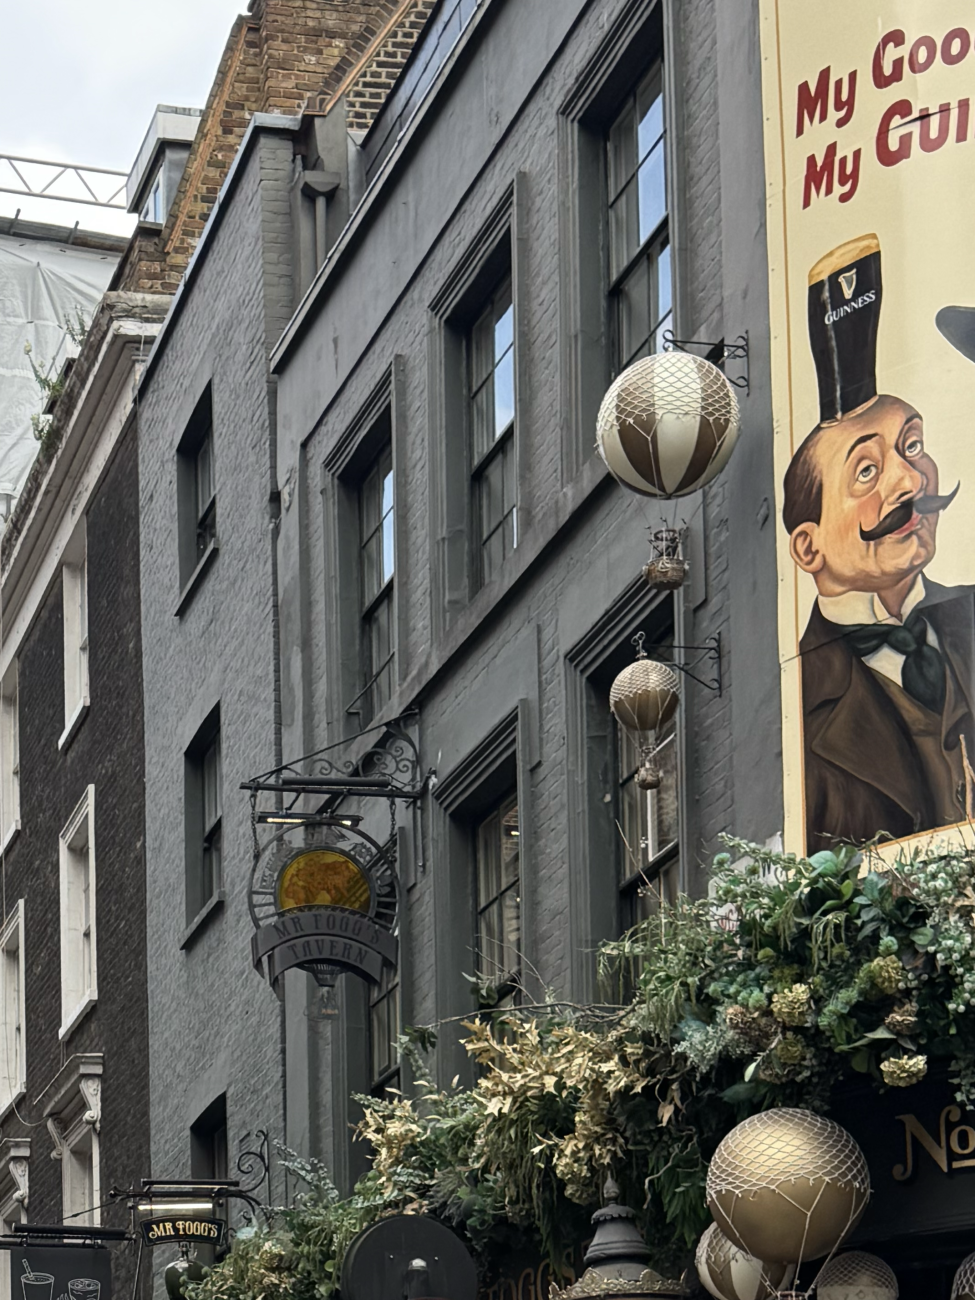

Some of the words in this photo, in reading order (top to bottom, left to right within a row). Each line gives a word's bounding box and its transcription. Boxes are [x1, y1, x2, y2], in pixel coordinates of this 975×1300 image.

[796, 65, 857, 139] My
[872, 27, 975, 90] Goo
[802, 141, 862, 210] My
[876, 98, 975, 168] GUI
[824, 289, 875, 324] GUINNESS
[276, 915, 303, 940] MR
[314, 912, 381, 946] FOGG'S
[287, 938, 369, 966] TAVERN
[149, 1221, 175, 1239] MR
[175, 1220, 219, 1238] FOGG'S
